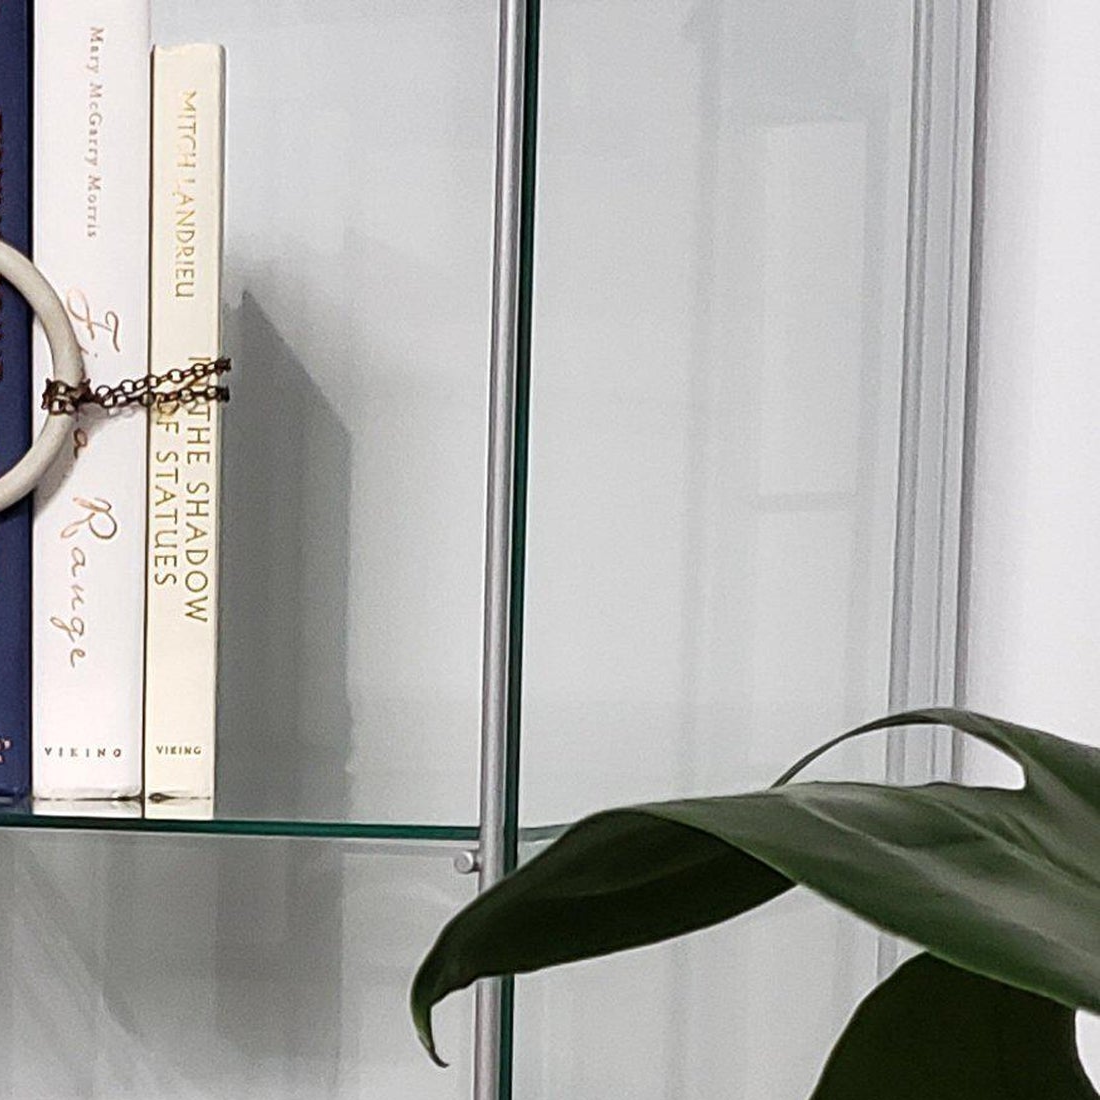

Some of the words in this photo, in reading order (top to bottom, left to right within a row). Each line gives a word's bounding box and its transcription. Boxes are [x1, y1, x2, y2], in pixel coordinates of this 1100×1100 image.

[85, 27, 105, 73] Mary
[84, 82, 104, 168] McGarry
[176, 90, 197, 168] MITCH
[86, 174, 103, 238] Morris
[173, 177, 196, 299] LANDRIEU
[186, 404, 211, 465] THE
[154, 451, 179, 586] STATUES
[184, 482, 210, 623] SHADOW
[50, 497, 117, 668] Range
[155, 745, 202, 756] VIKING
